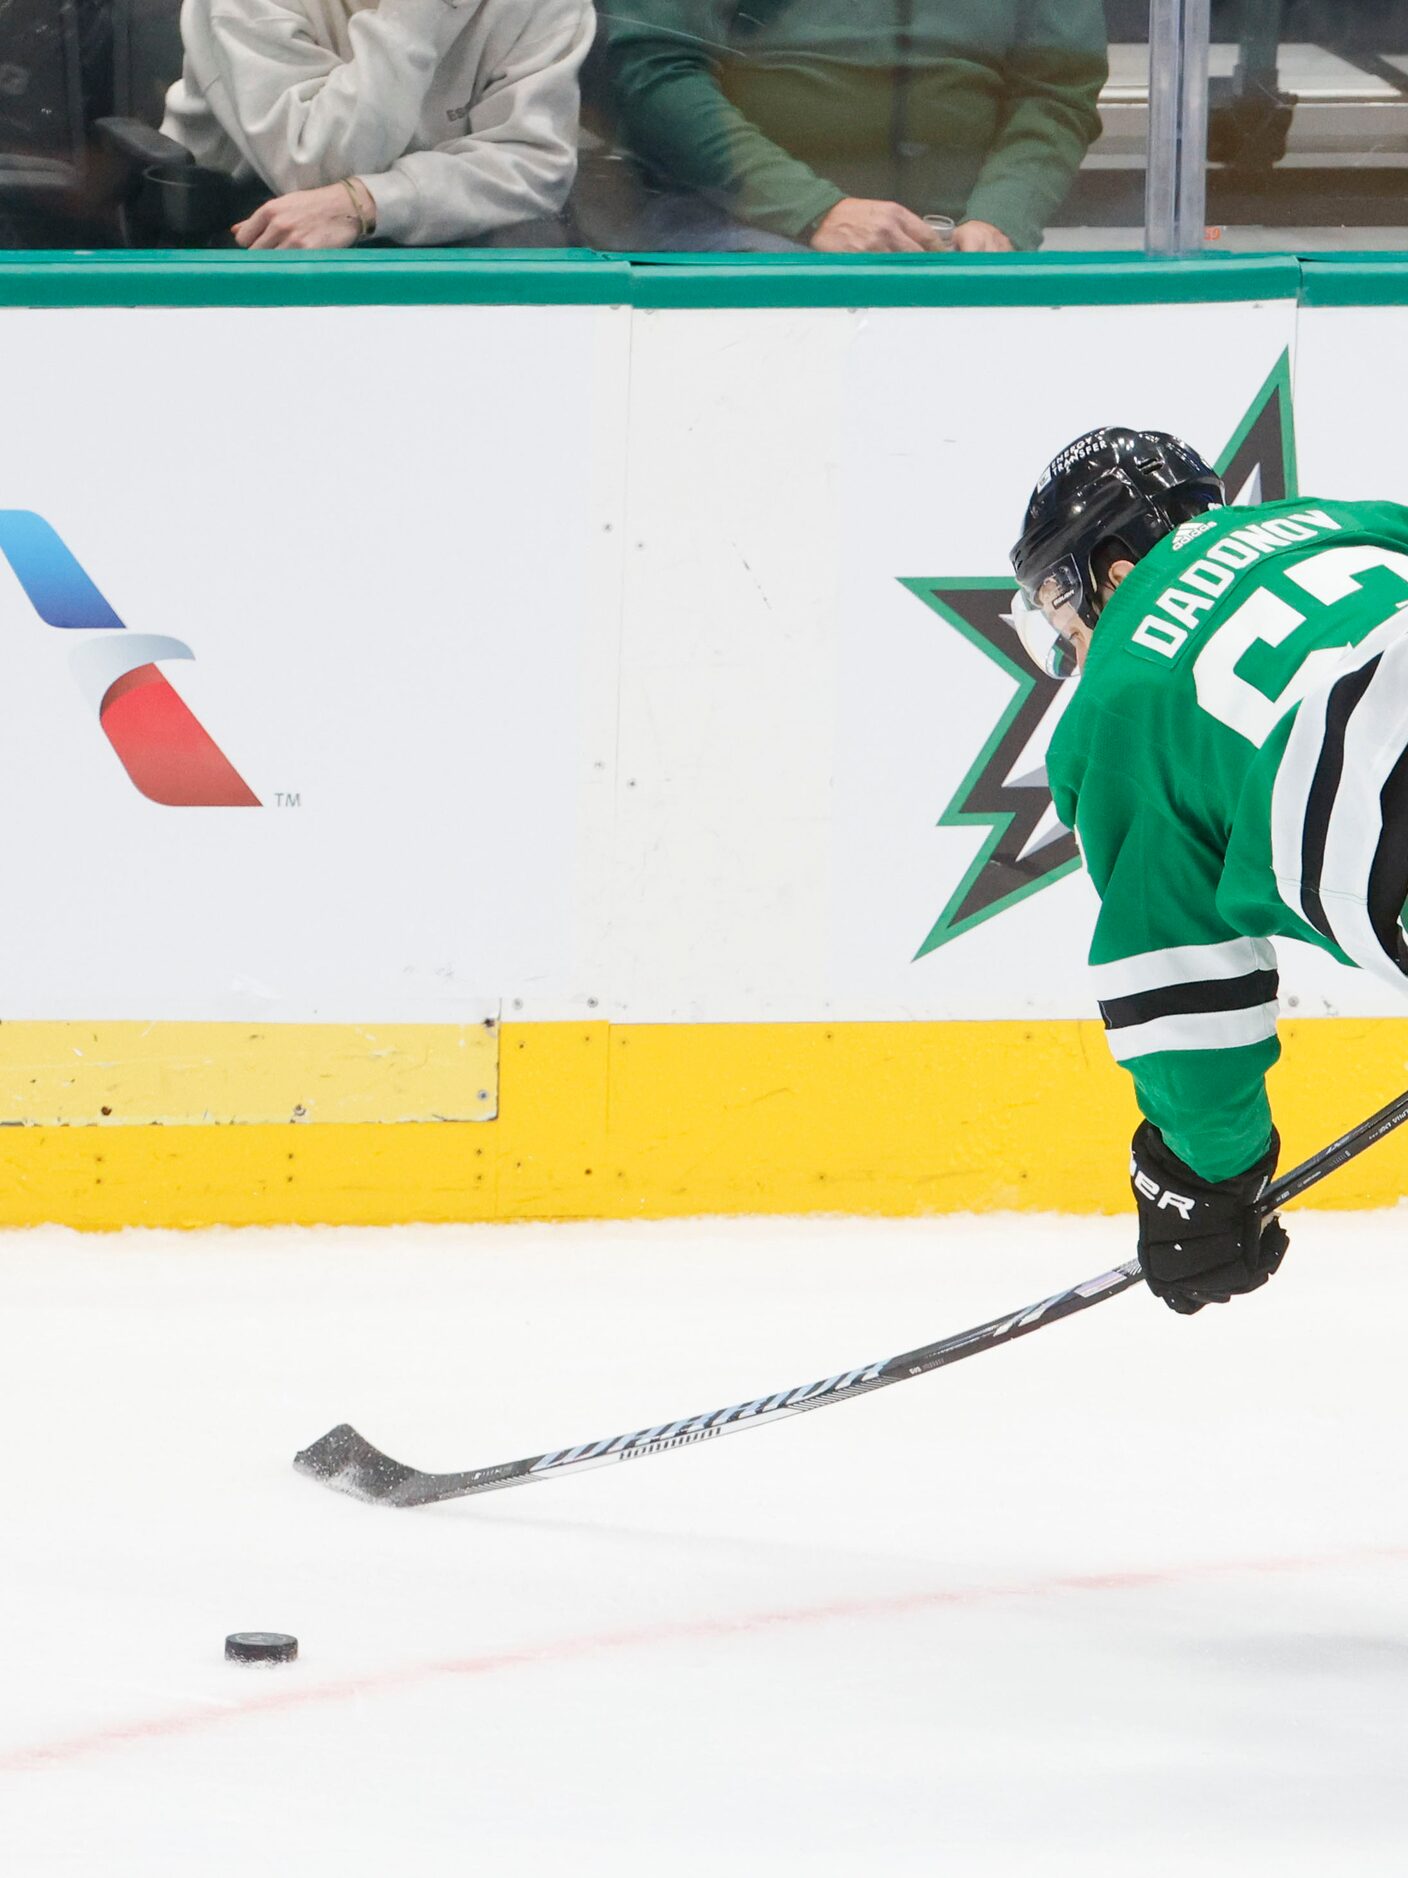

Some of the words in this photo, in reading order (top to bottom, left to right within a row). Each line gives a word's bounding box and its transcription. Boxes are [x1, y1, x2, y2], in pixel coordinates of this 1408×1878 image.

[1050, 436, 1093, 468] ENERGY
[1052, 439, 1108, 477] TRANSFER
[1172, 520, 1218, 551] adidas
[1131, 510, 1342, 659] DADONOV
[274, 792, 302, 808] TM
